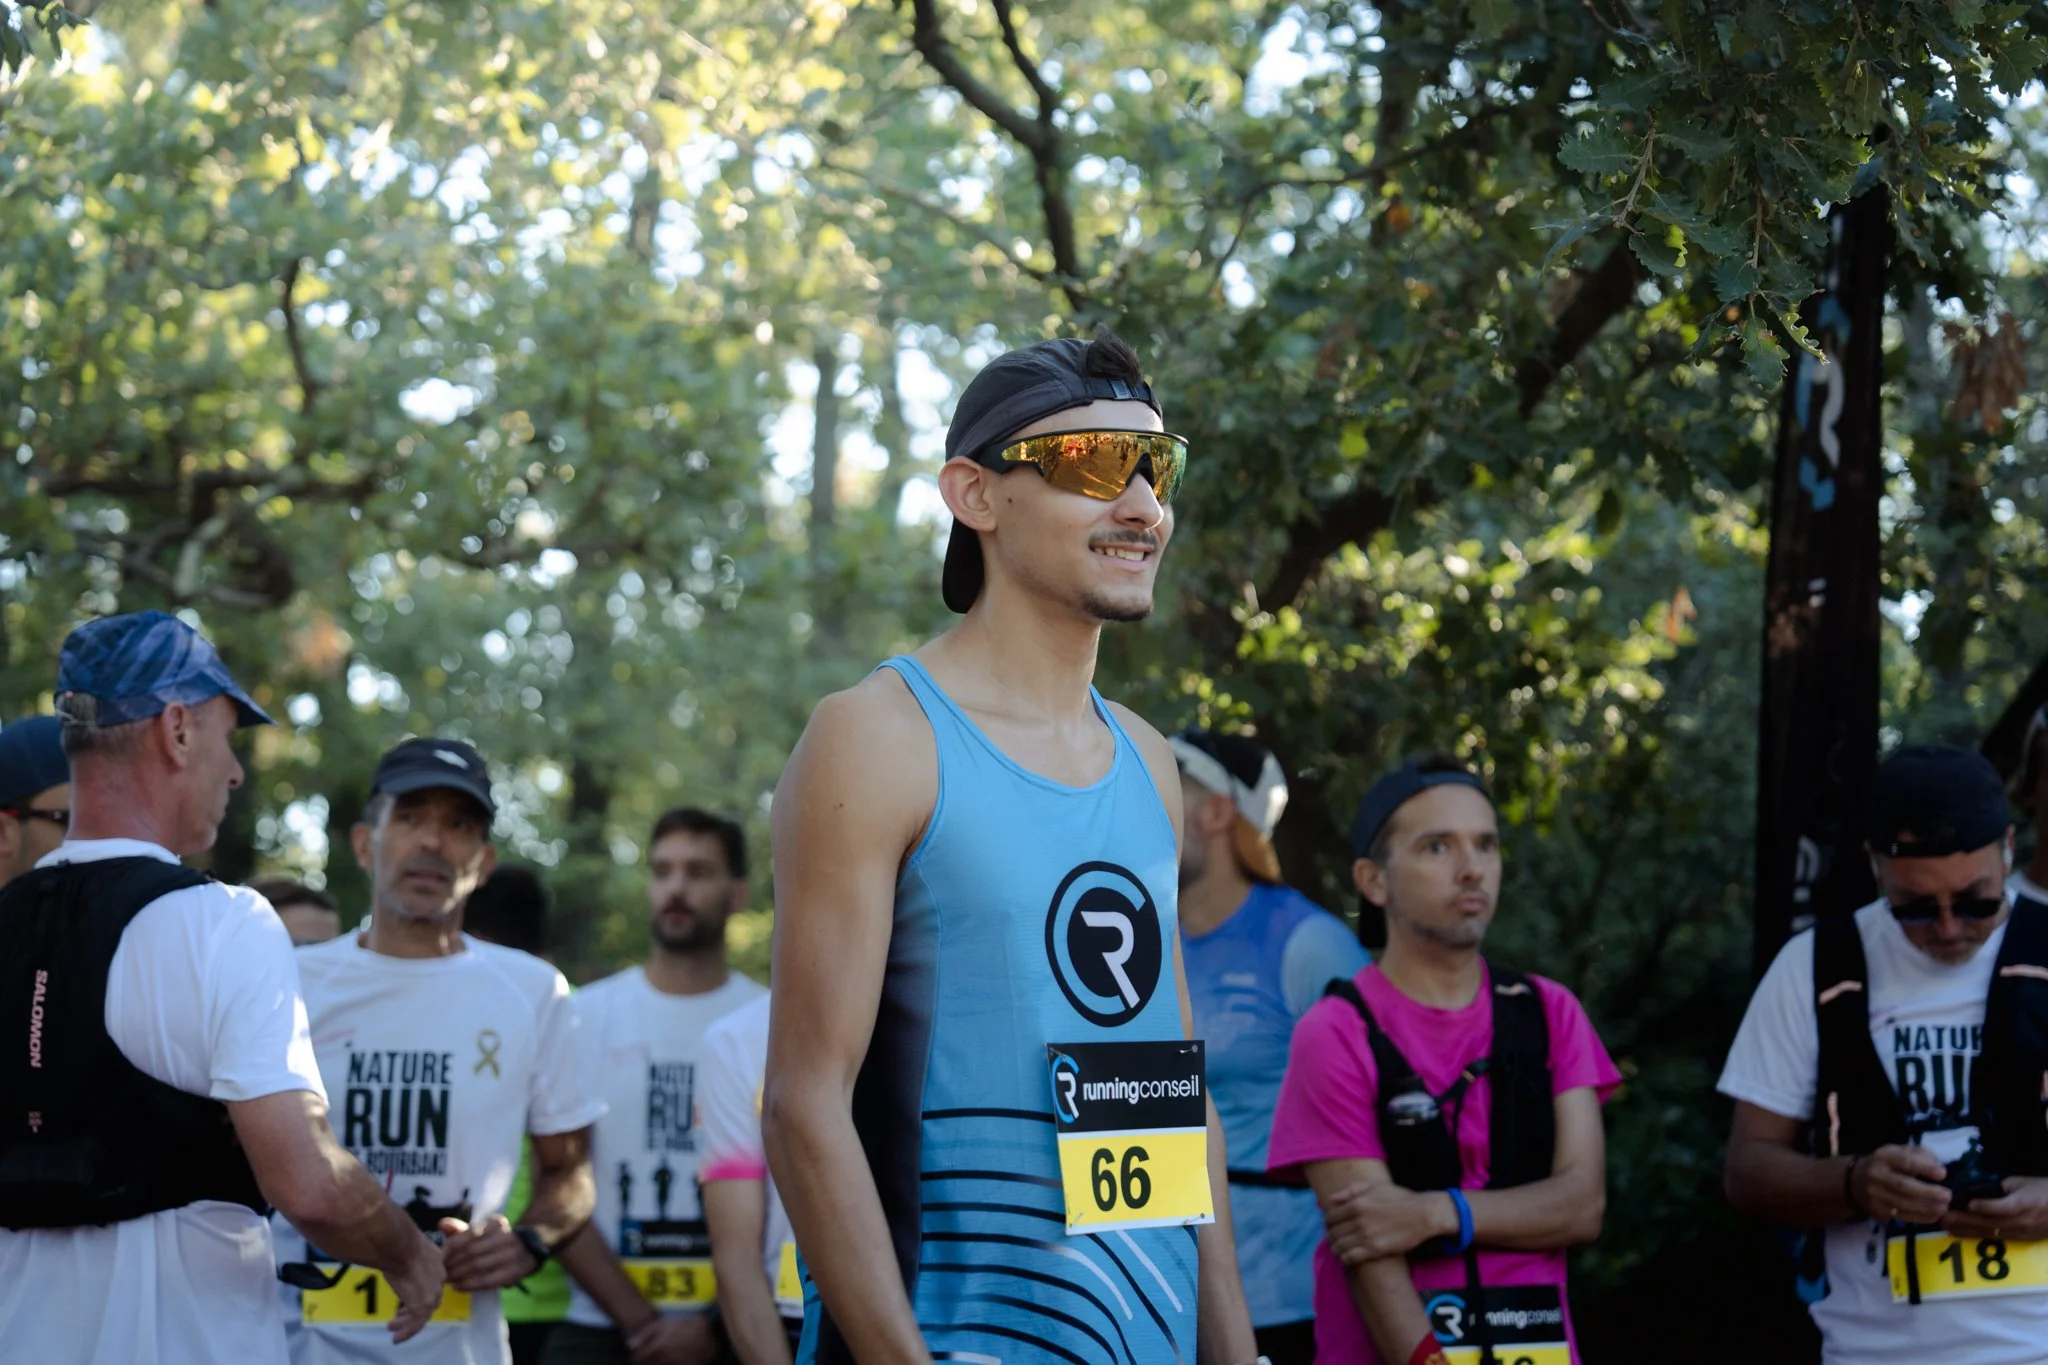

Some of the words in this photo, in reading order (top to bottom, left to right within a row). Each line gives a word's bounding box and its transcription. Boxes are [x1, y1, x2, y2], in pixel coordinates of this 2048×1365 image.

[30, 969, 48, 1068] SALOMON
[348, 1051, 453, 1084] NATURE
[1083, 1074, 1200, 1105] runningconseil
[345, 1088, 449, 1148] RUN
[1091, 1145, 1152, 1212] 66
[1939, 1238, 2010, 1283] 18
